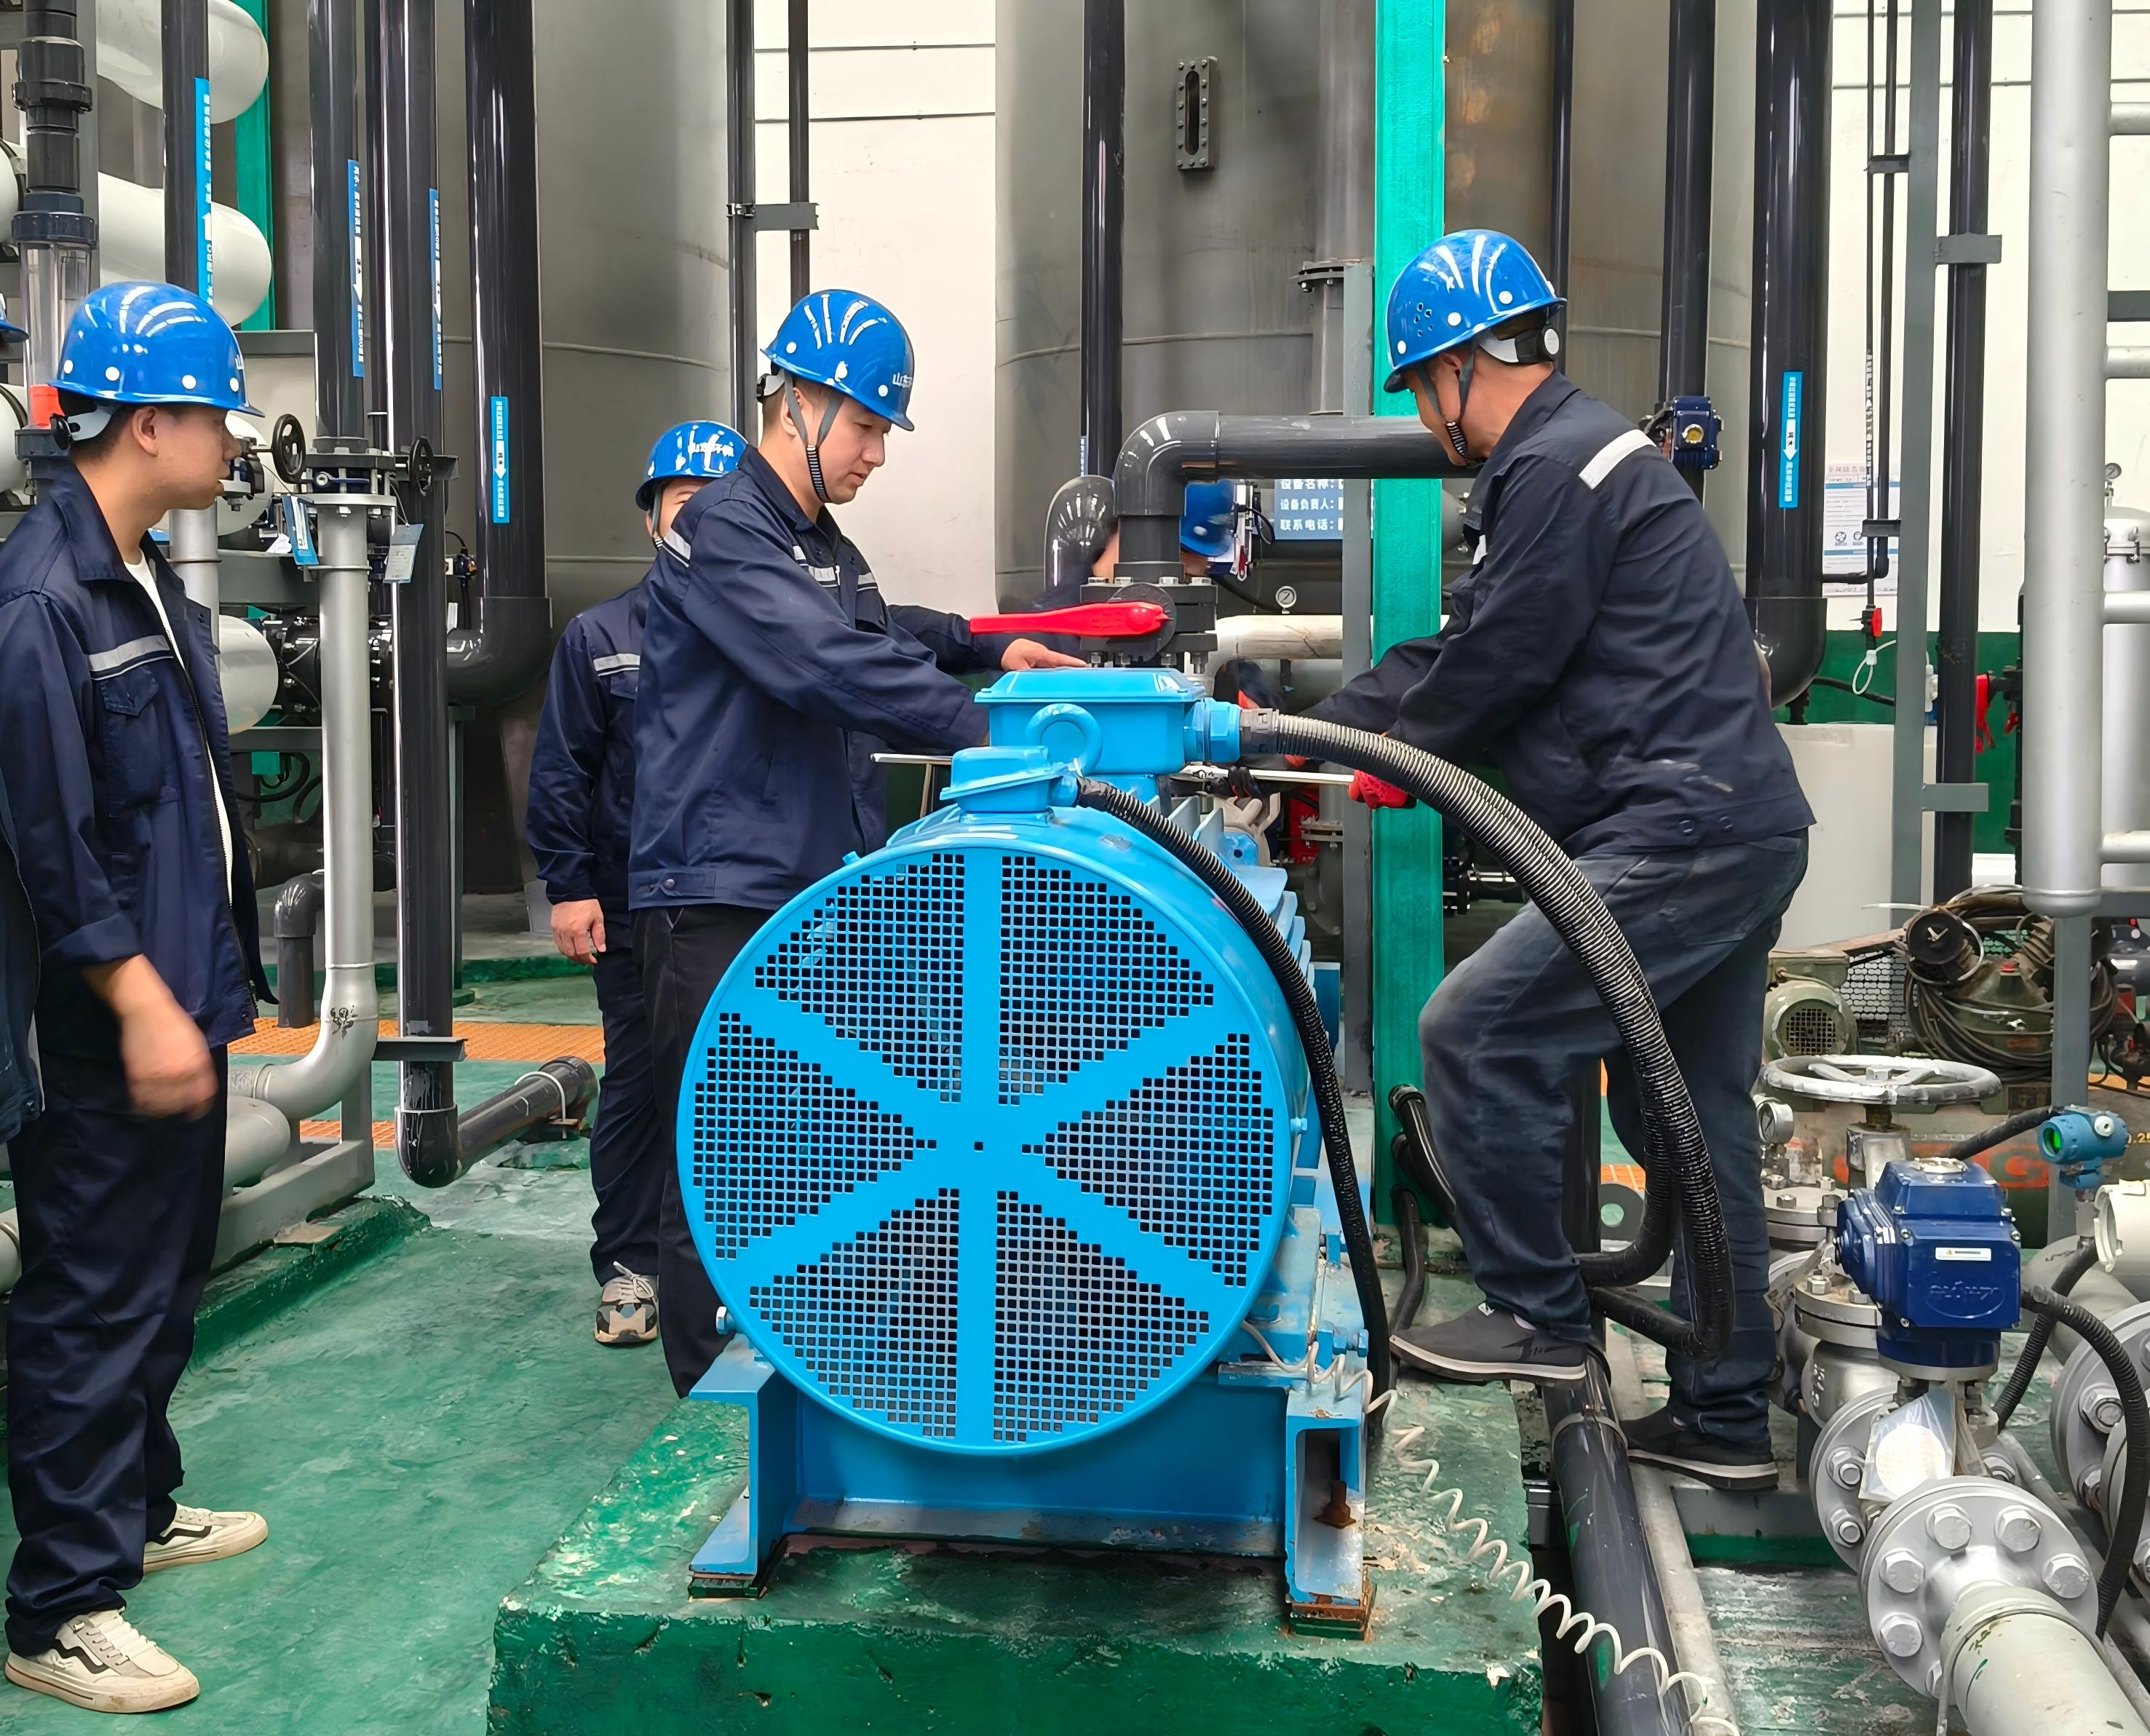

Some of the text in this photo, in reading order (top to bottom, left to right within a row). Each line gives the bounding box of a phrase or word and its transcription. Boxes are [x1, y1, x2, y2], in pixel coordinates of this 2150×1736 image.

[1280, 498, 1334, 510] 设备负责人：
[1280, 518, 1334, 531] 联系电话：
